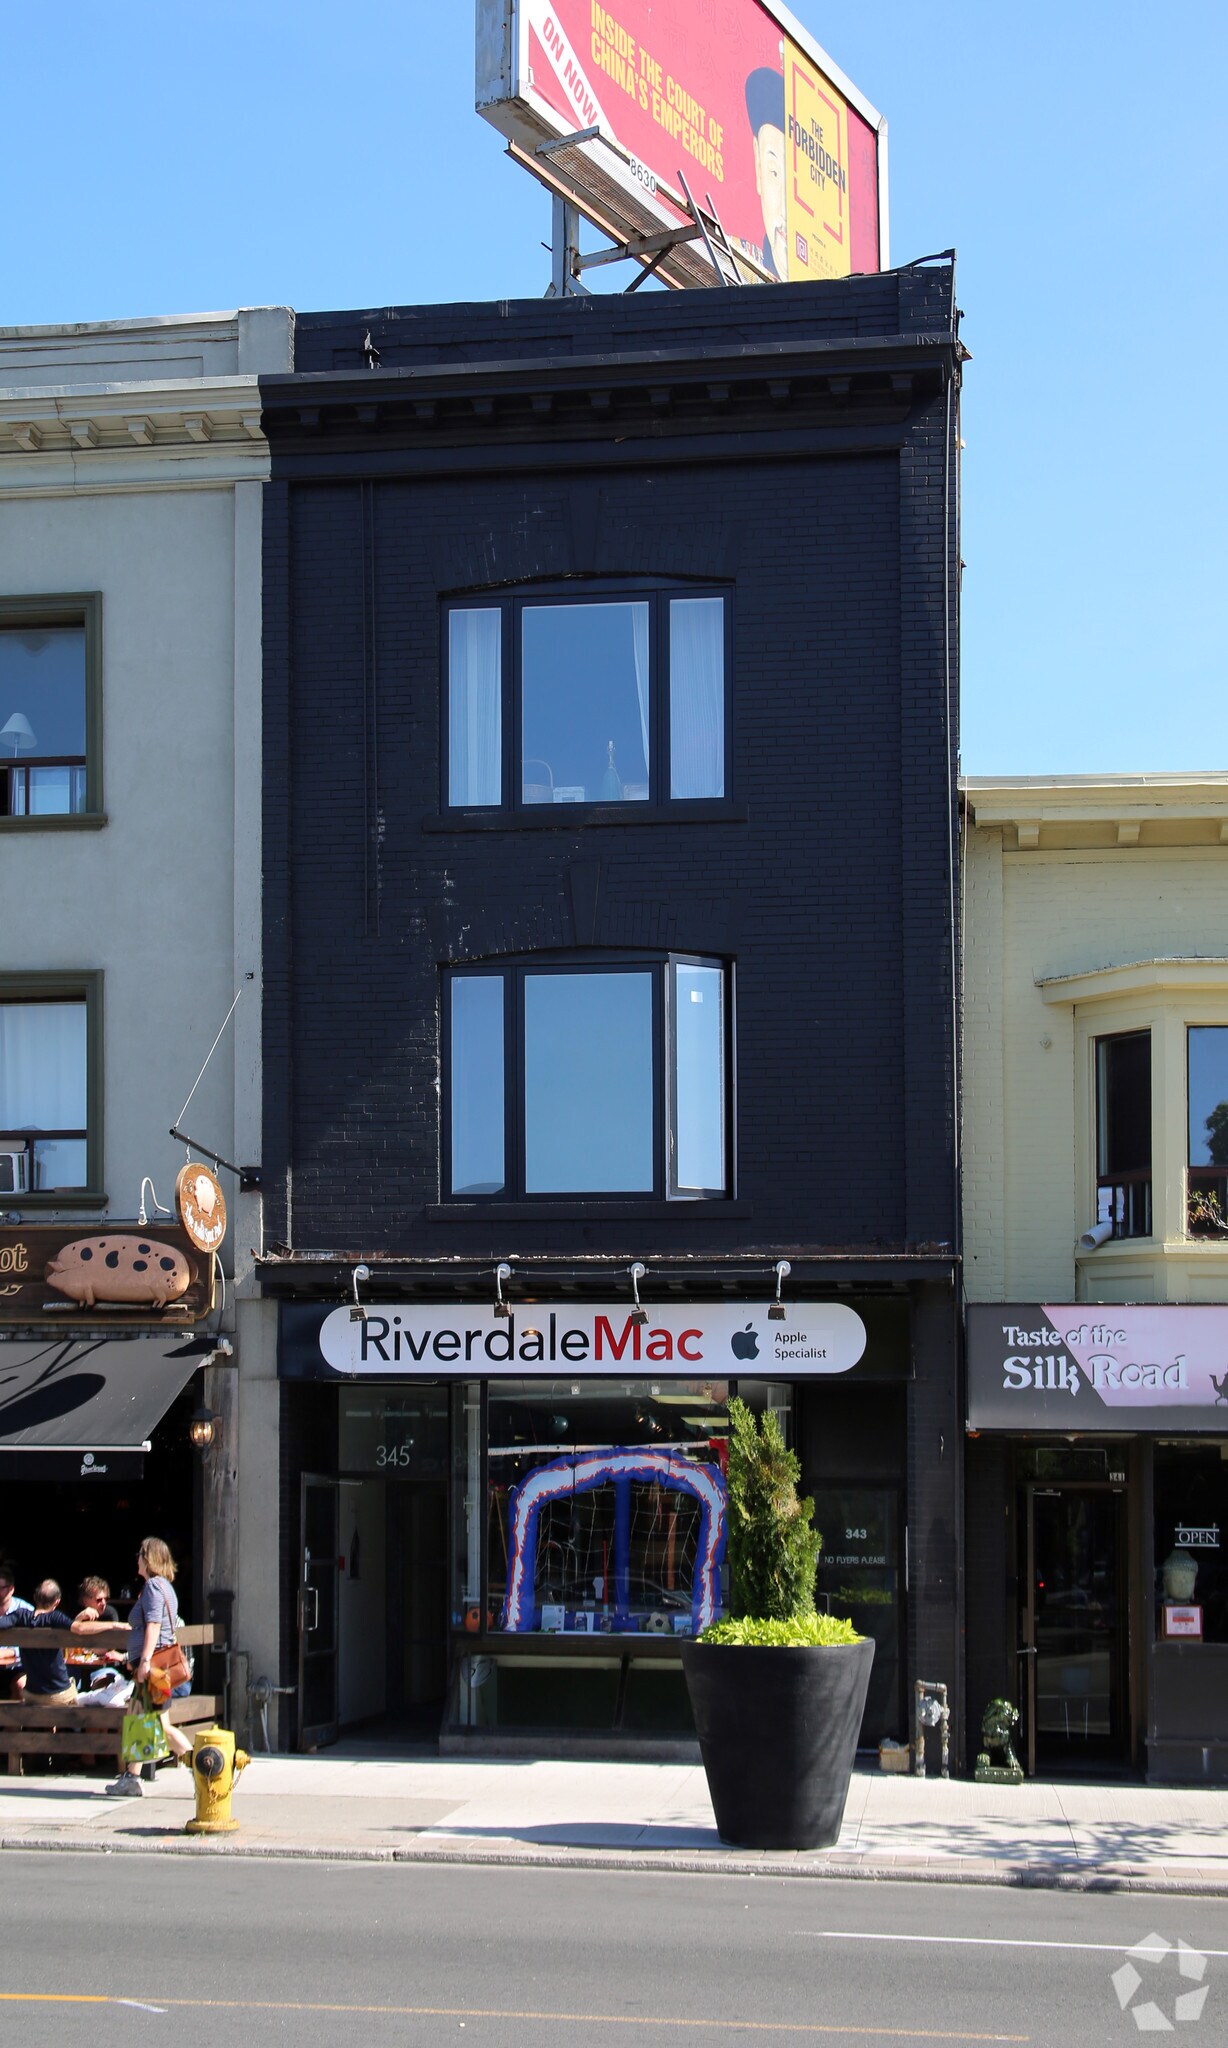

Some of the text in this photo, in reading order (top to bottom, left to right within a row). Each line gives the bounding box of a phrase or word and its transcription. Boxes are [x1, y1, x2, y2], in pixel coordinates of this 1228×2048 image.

[543, 16, 598, 126] ON NOW
[590, 0, 635, 67] INSIDE
[638, 46, 663, 95] THE
[666, 75, 706, 131] COURT
[708, 117, 724, 151] OF
[590, 31, 649, 111] CHINA'S
[652, 89, 725, 183] EMPERORS
[810, 117, 824, 144] THE
[788, 113, 846, 194] FORBIDDEN
[630, 158, 656, 193] 8630
[810, 164, 826, 191] CITY
[774, 1332, 807, 1344] Apple
[1002, 1324, 1128, 1348] Taste of the
[774, 1347, 827, 1360] Specialist
[1002, 1353, 1189, 1396] Silk Road
[376, 1445, 410, 1466] 345
[845, 1528, 867, 1539] 343
[1178, 1531, 1216, 1544] OPEN
[824, 1555, 886, 1565] NO FLYERS PLEASE
